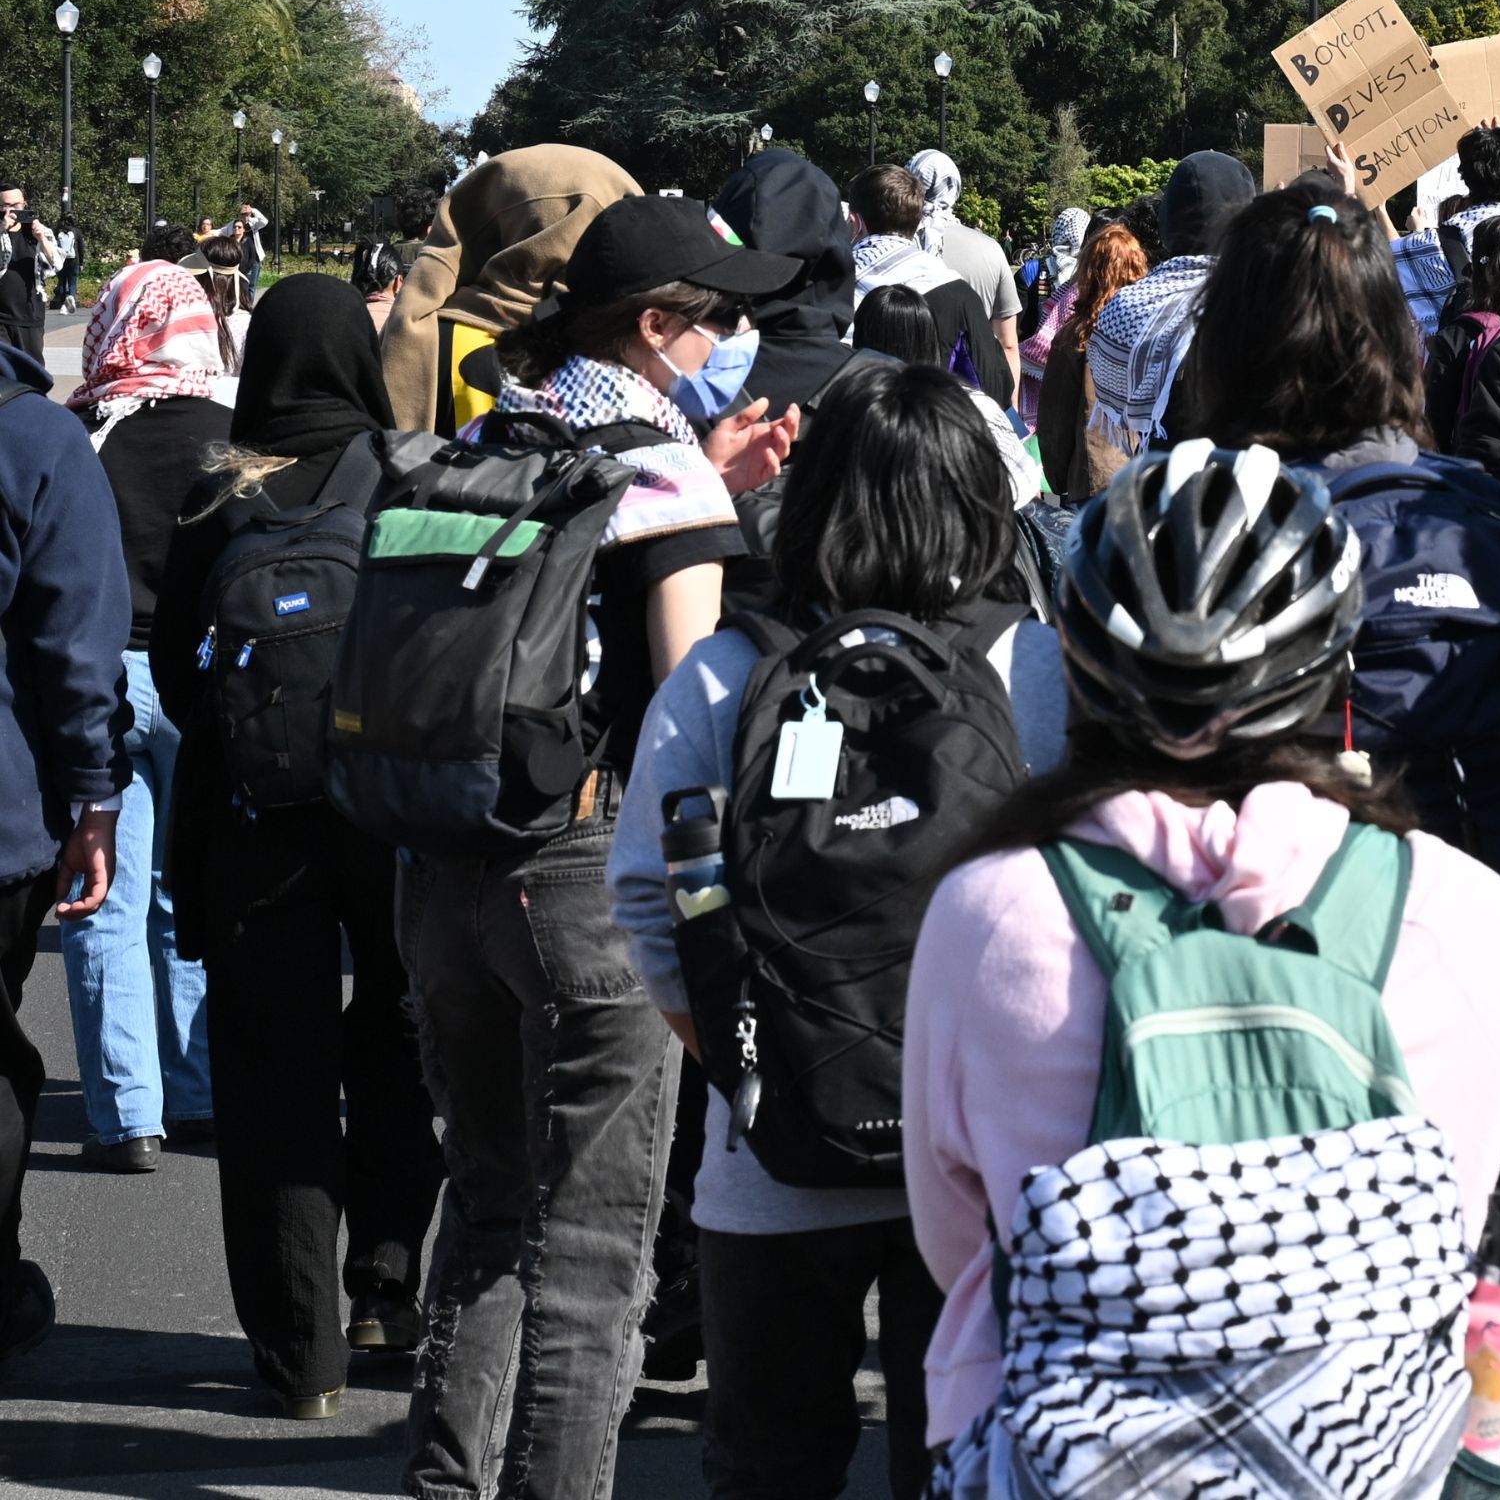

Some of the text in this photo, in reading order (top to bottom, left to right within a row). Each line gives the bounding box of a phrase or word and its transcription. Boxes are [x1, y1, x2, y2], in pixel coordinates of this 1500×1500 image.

[1290, 5, 1398, 86] BOYCOTT.
[1326, 54, 1427, 134] DIVEST.
[1355, 106, 1459, 186] SANCTION.
[835, 808, 890, 826] NORTH
[851, 820, 890, 831] FACE
